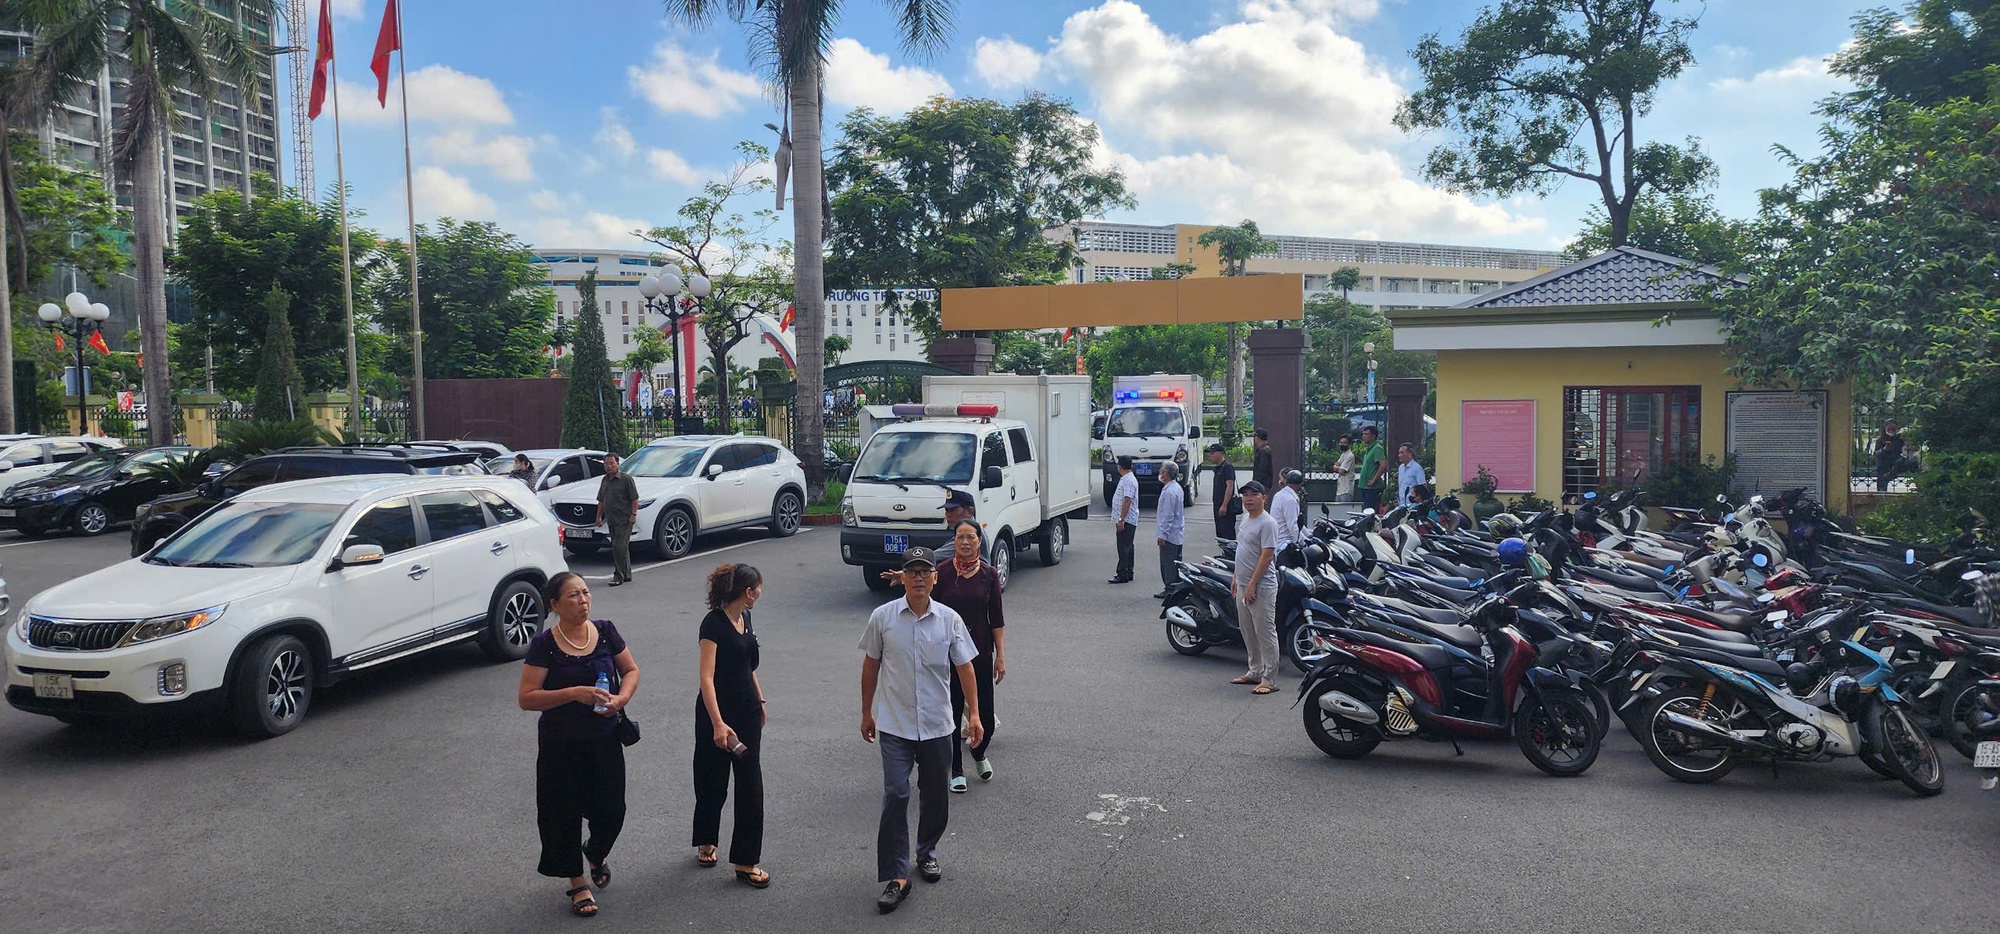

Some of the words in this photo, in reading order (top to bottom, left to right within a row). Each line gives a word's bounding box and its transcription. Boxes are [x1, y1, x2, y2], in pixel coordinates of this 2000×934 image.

[873, 290, 905, 301] THT
[890, 535, 903, 544] 15A
[885, 543, 908, 552] 008.12
[45, 675, 61, 685] 15K
[39, 686, 68, 697] 100.27
